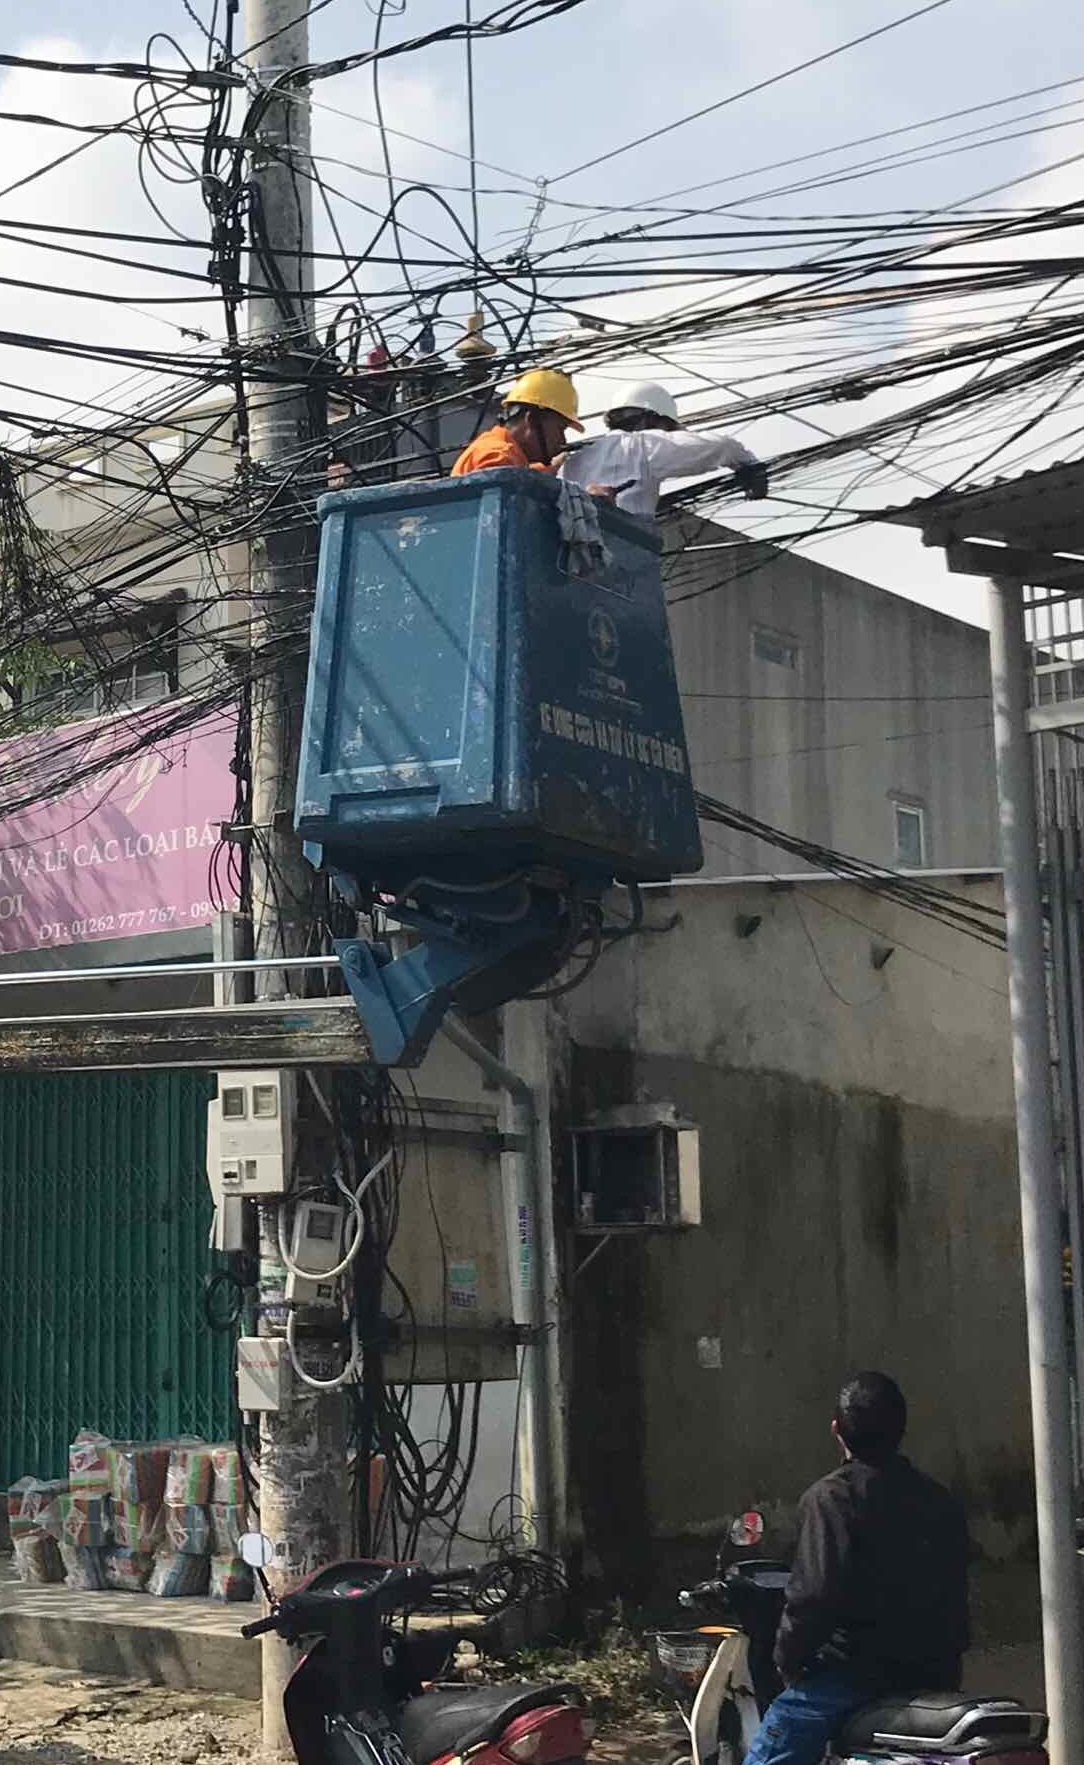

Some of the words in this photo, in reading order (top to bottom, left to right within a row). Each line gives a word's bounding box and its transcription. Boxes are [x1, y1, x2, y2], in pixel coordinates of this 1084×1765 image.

[73, 837, 119, 866] CÁC
[124, 829, 179, 857] LOẠI
[185, 819, 221, 848] BÁ
[72, 915, 114, 936] 01262
[119, 911, 146, 928] 777
[149, 906, 176, 923] 767
